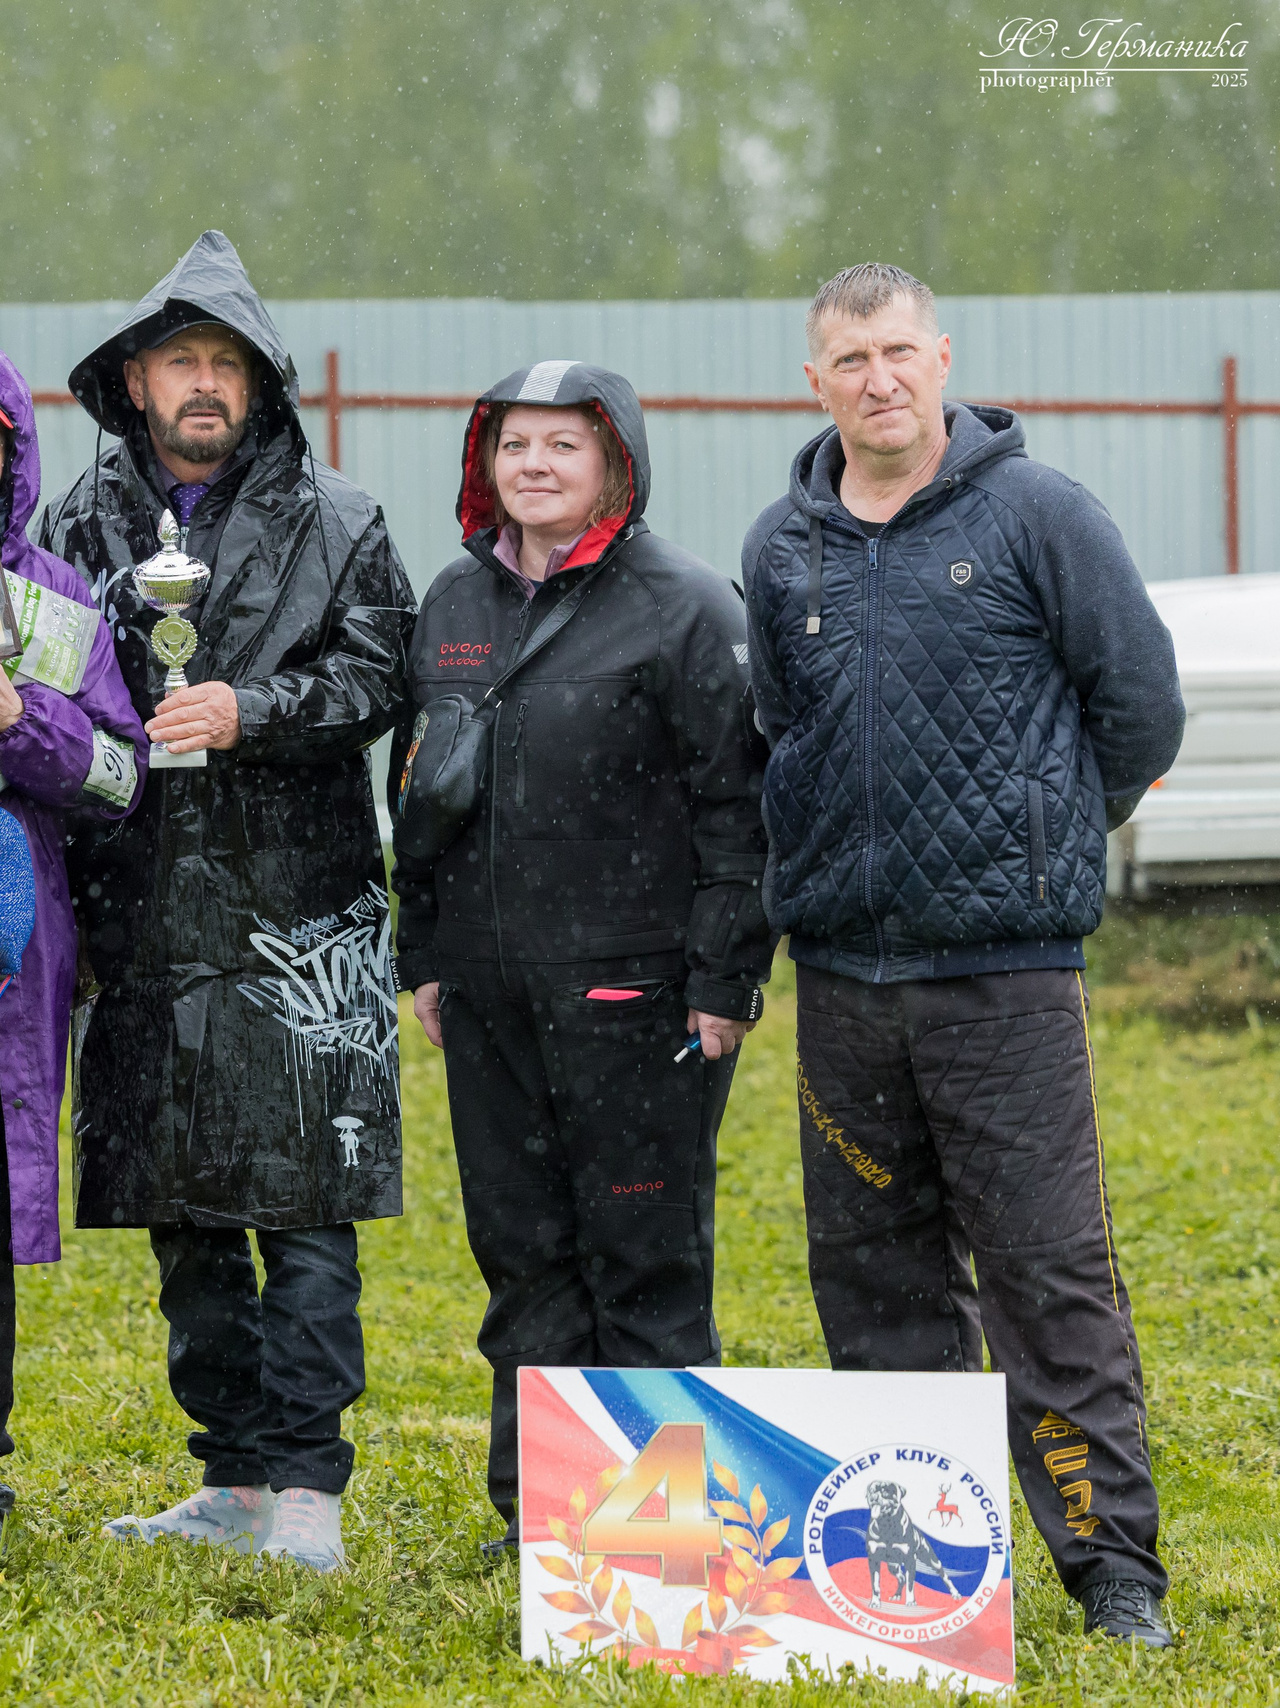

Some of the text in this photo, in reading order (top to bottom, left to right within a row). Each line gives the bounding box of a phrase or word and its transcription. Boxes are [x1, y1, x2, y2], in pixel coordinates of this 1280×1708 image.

[438, 657, 485, 667] outdoor
[440, 643, 492, 655] buono
[391, 961, 401, 990] buono
[749, 989, 759, 1019] buono
[612, 1180, 664, 1194] buono
[583, 1422, 723, 1587] 4
[809, 1449, 1004, 1555] РОТВЕЙЛЕР КЛУБ РОССИИ
[823, 1585, 995, 1641] НИЖЕГОРОДСКОЕ РО
